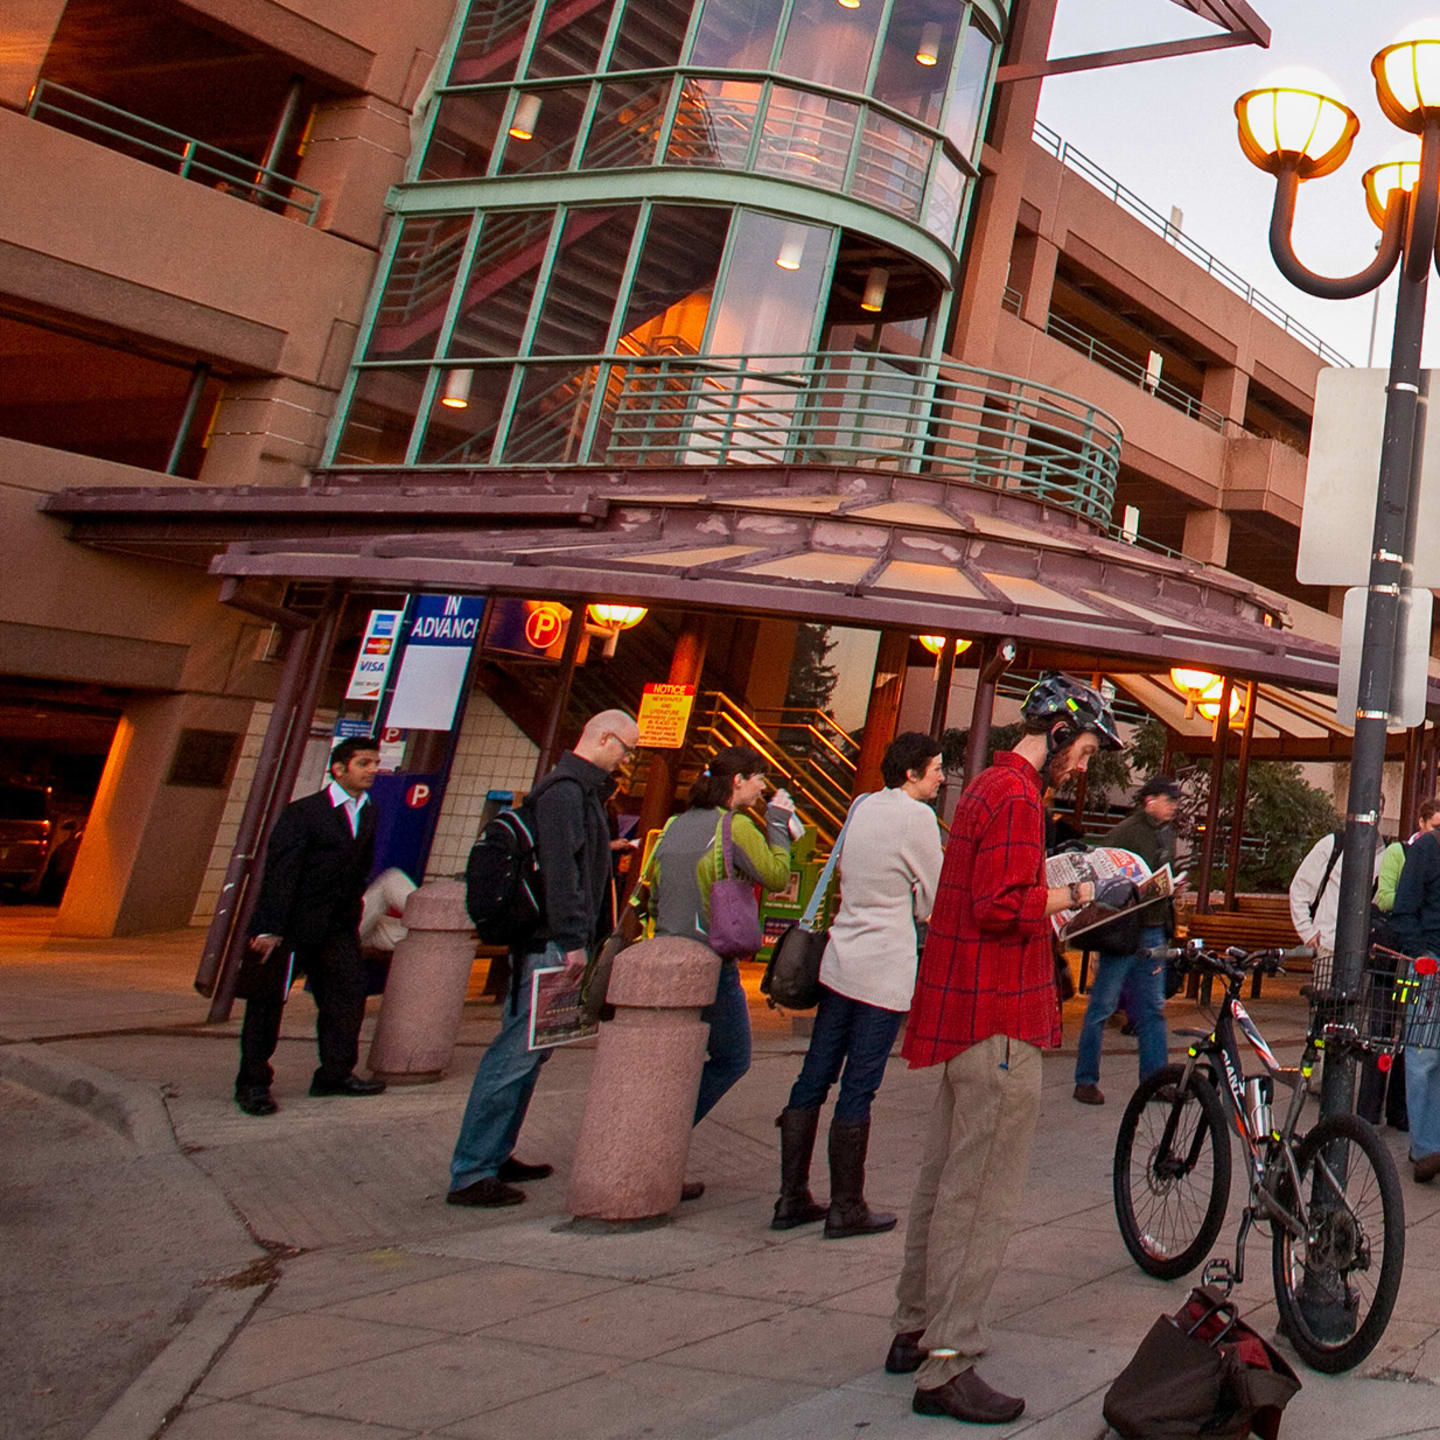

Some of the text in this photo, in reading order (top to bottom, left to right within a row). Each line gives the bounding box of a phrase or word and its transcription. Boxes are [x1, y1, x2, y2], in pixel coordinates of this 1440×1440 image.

[443, 596, 462, 616] IN
[534, 613, 555, 640] P
[360, 660, 385, 672] VISA
[653, 684, 685, 695] NOTICE
[412, 784, 429, 805] P
